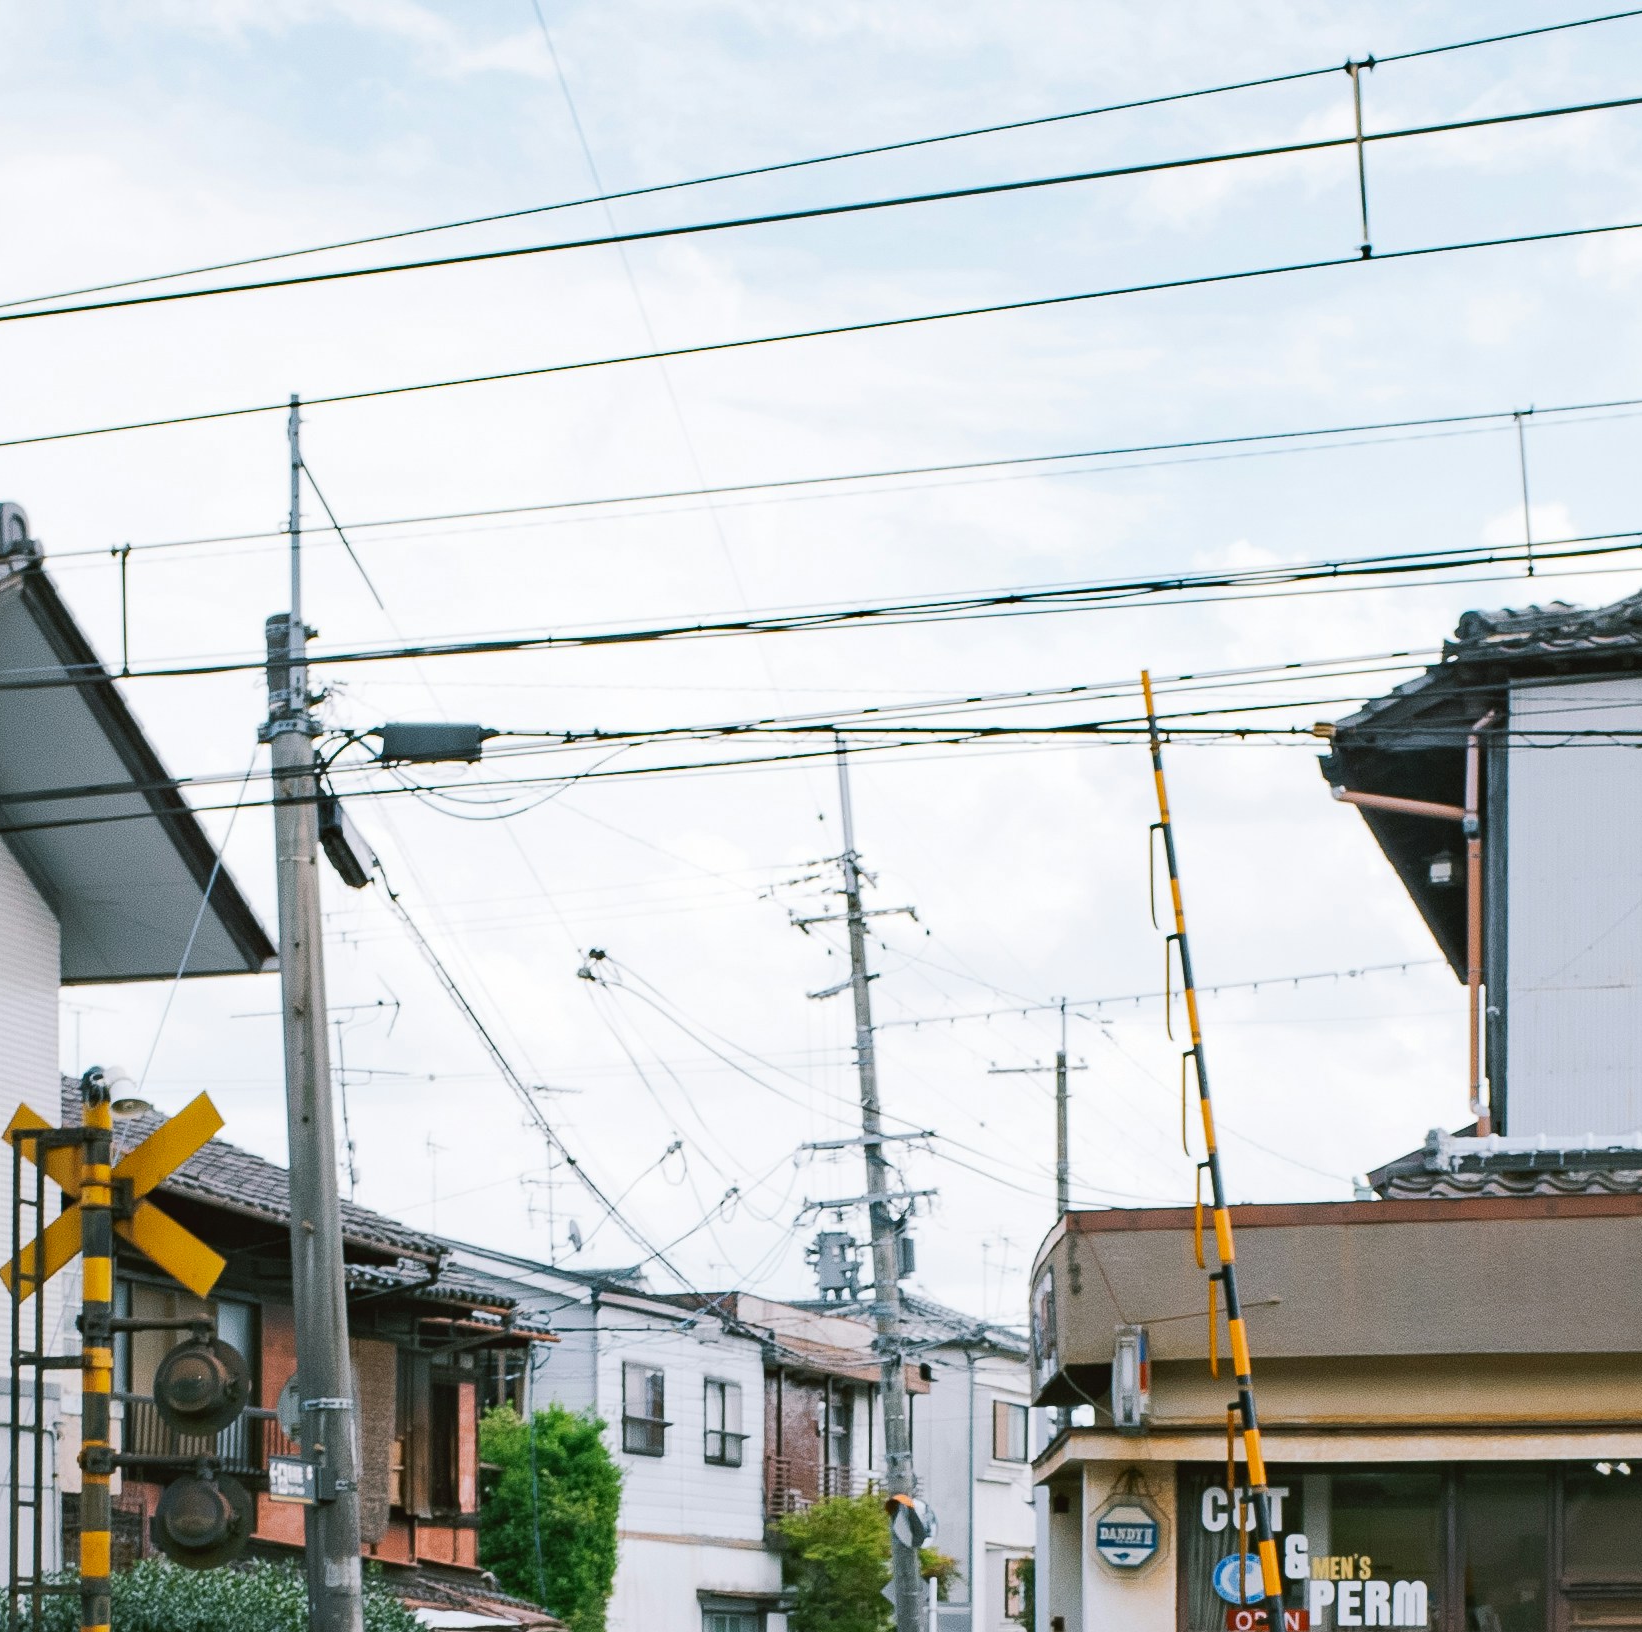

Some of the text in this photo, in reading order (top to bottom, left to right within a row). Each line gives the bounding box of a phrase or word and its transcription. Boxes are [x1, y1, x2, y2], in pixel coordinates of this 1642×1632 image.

[1201, 1487, 1289, 1532] CUT
[1100, 1527, 1143, 1540] DANDY
[1285, 1533, 1309, 1580] &
[1312, 1554, 1372, 1580] MEN'S
[1310, 1579, 1428, 1627] PERM
[1235, 1611, 1300, 1631] ON
